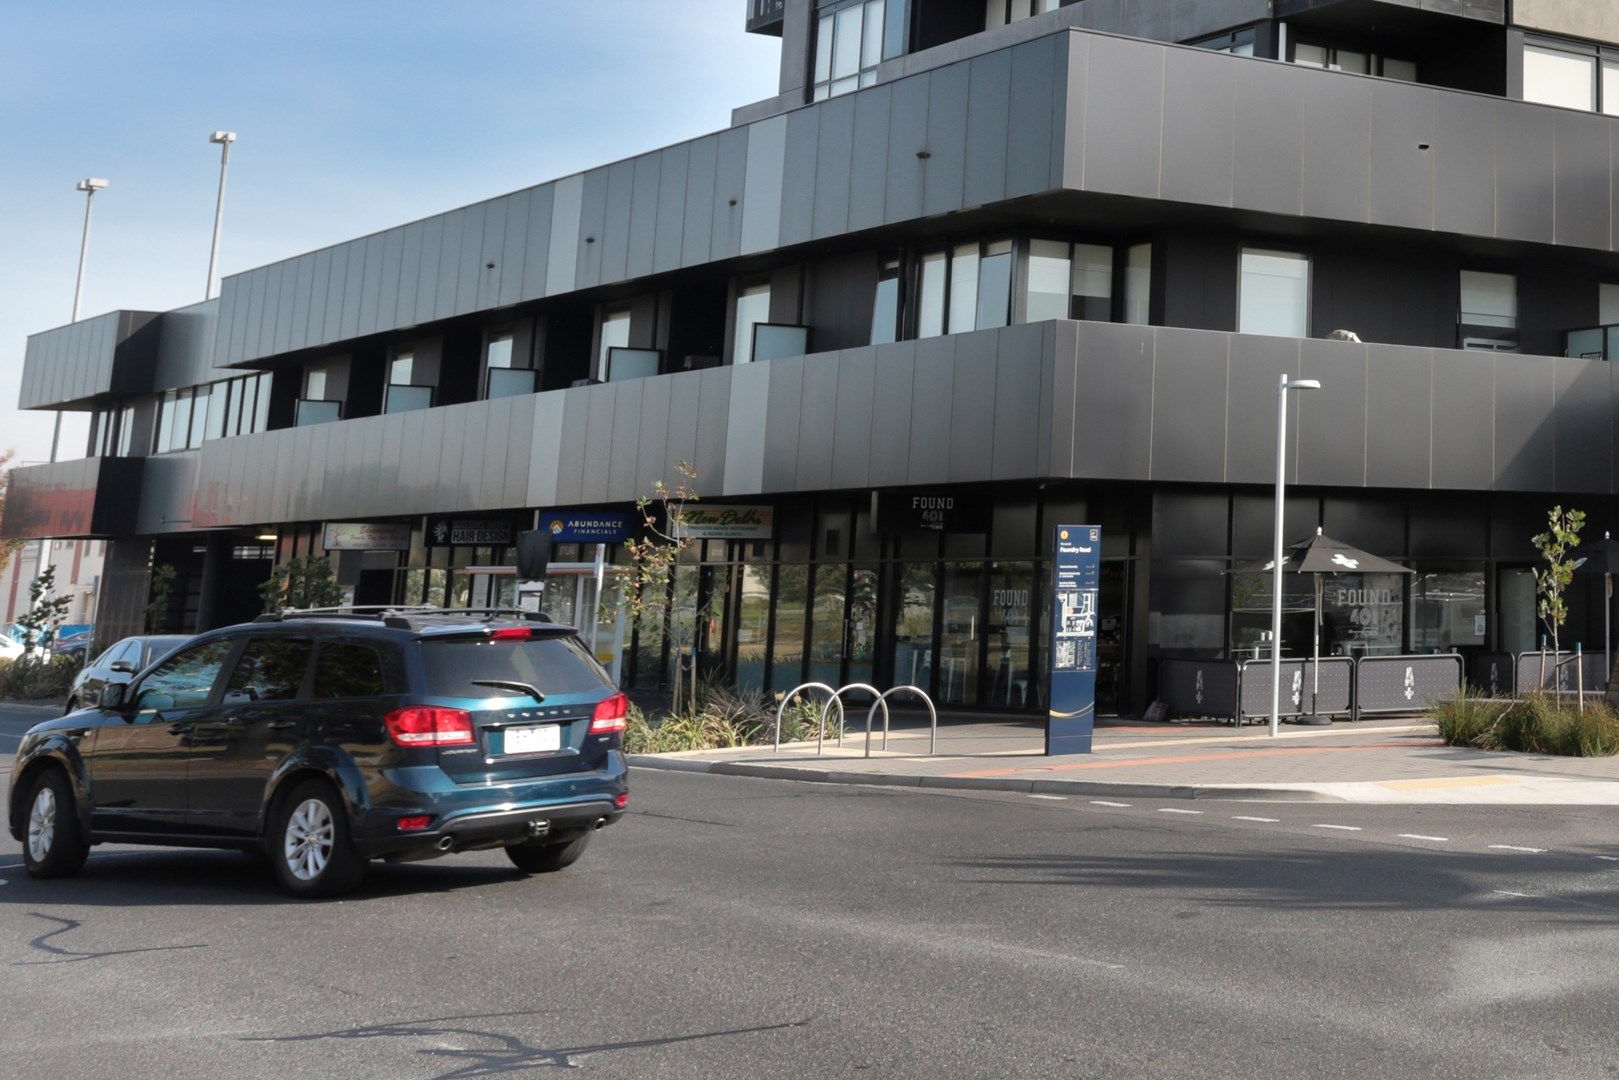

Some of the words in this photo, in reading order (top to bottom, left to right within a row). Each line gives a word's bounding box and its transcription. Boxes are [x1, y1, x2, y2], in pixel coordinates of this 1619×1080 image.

[912, 496, 955, 510] FOUND
[453, 529, 475, 542] HAIR
[476, 529, 512, 543] DESIGN
[993, 589, 1029, 607] FOUND
[1337, 589, 1391, 606] FOUND
